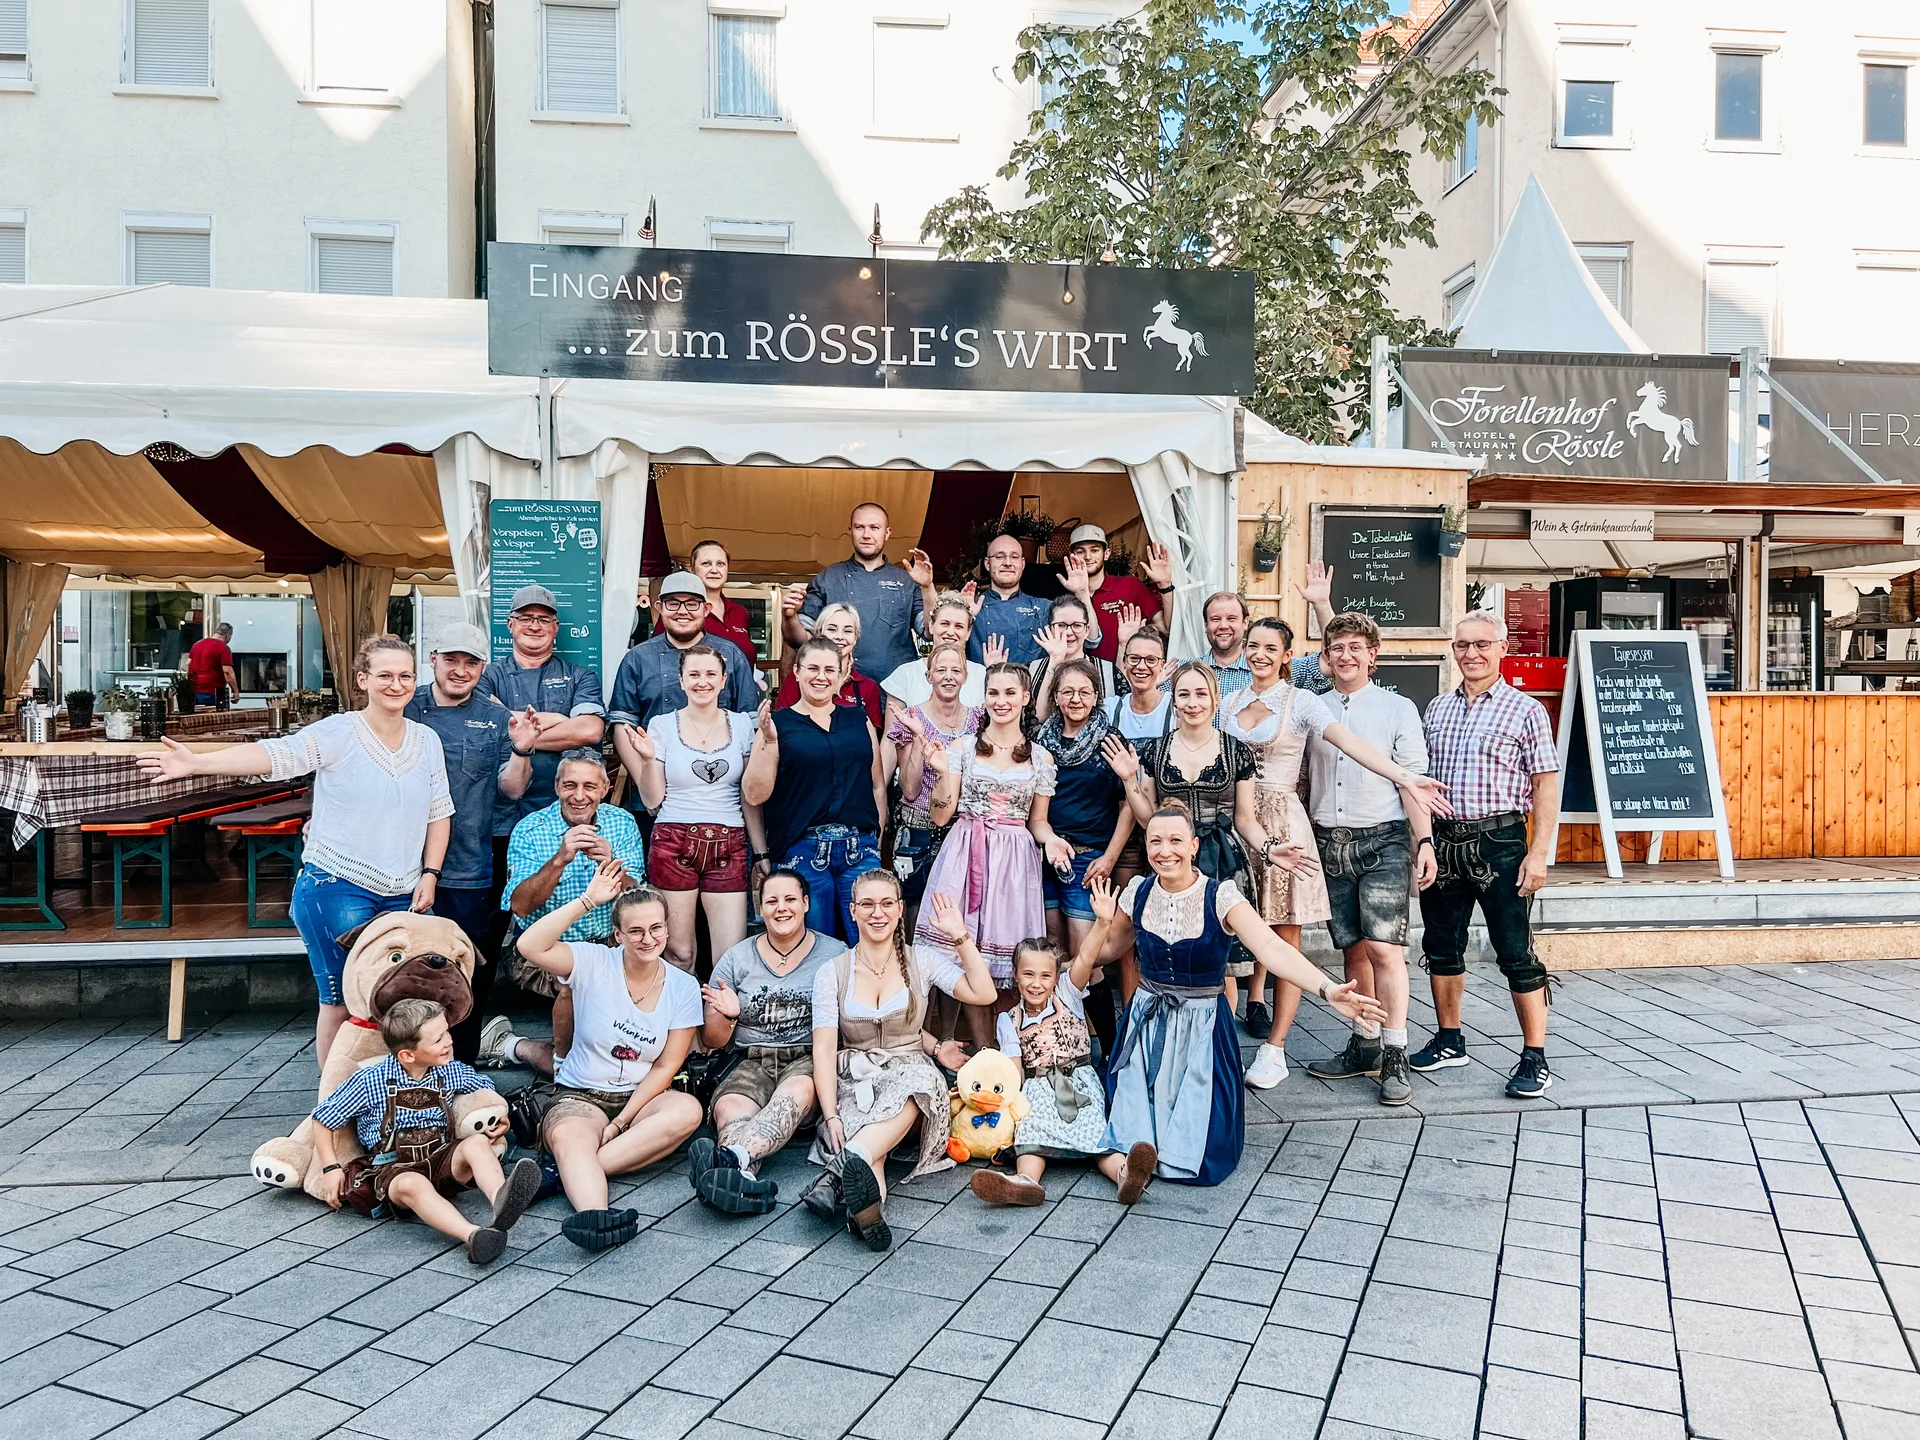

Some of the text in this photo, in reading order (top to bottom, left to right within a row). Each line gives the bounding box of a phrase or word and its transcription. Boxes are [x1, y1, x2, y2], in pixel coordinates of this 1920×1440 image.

[529, 264, 684, 302] EINGANG
[626, 327, 729, 360] zum
[993, 329, 1127, 371] WIRT
[1429, 384, 1617, 433] Forellenhof
[1463, 432, 1516, 440] HOTEL &
[1522, 429, 1624, 466] Rössle
[572, 505, 598, 513] WIRT
[492, 528, 544, 538] Vorspeisen
[1532, 519, 1653, 534] Wein & Getränkeausschank
[492, 539, 536, 549] & Vesper
[1351, 529, 1413, 544] Die Tobelmühle
[1348, 546, 1411, 560] Unsere Eventlocation
[1365, 571, 1378, 581] Mai
[1342, 596, 1367, 611] Jetzt
[1380, 610, 1405, 621] 2025
[1610, 645, 1655, 668] Tagesessen
[758, 1002, 810, 1024] Herz
[613, 1020, 657, 1045] Weinkind
